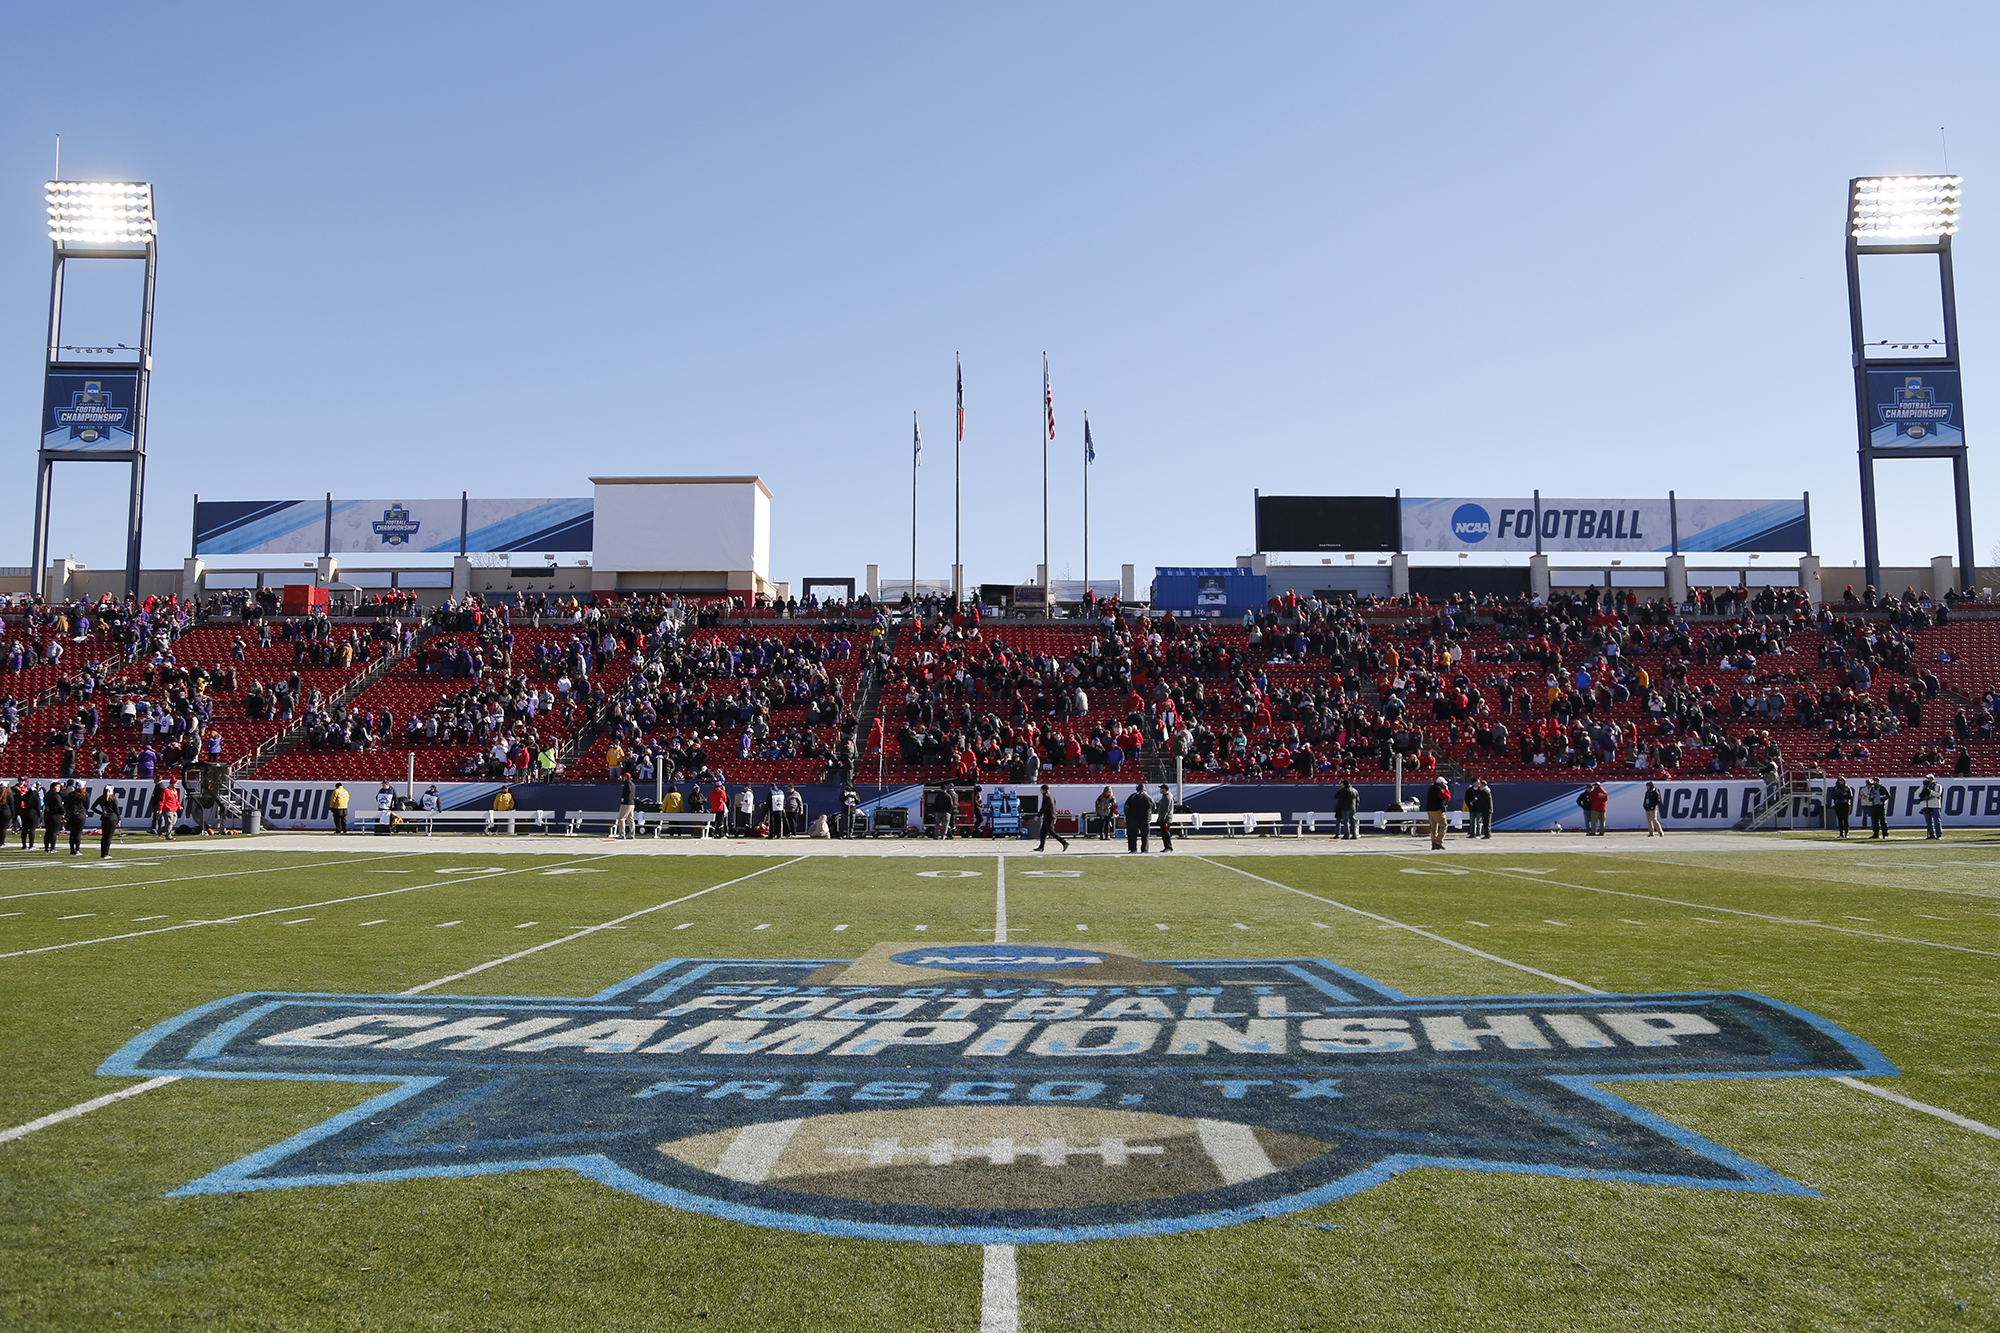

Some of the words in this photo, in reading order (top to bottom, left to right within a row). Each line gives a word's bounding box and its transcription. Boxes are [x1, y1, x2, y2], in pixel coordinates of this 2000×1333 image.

[1899, 402, 1931, 410] FOOTBALL
[61, 413, 122, 422] CHAMPIONSHIP
[1885, 409, 1948, 418] CHAMPIONSHIP
[1455, 522, 1490, 534] NCAA
[1497, 509, 1644, 538] FOOTBALL
[1656, 788, 1729, 819] NCAA
[915, 956, 1102, 964] NCAA
[702, 986, 882, 996] 2017
[900, 986, 1224, 997] DIVISION
[1249, 986, 1276, 995] I
[656, 995, 1322, 1019] FOOTBALL
[259, 1012, 1722, 1057] CHAMPIONSHIP
[632, 1080, 1144, 1105] FRISCO,
[1202, 1079, 1344, 1100] TX
